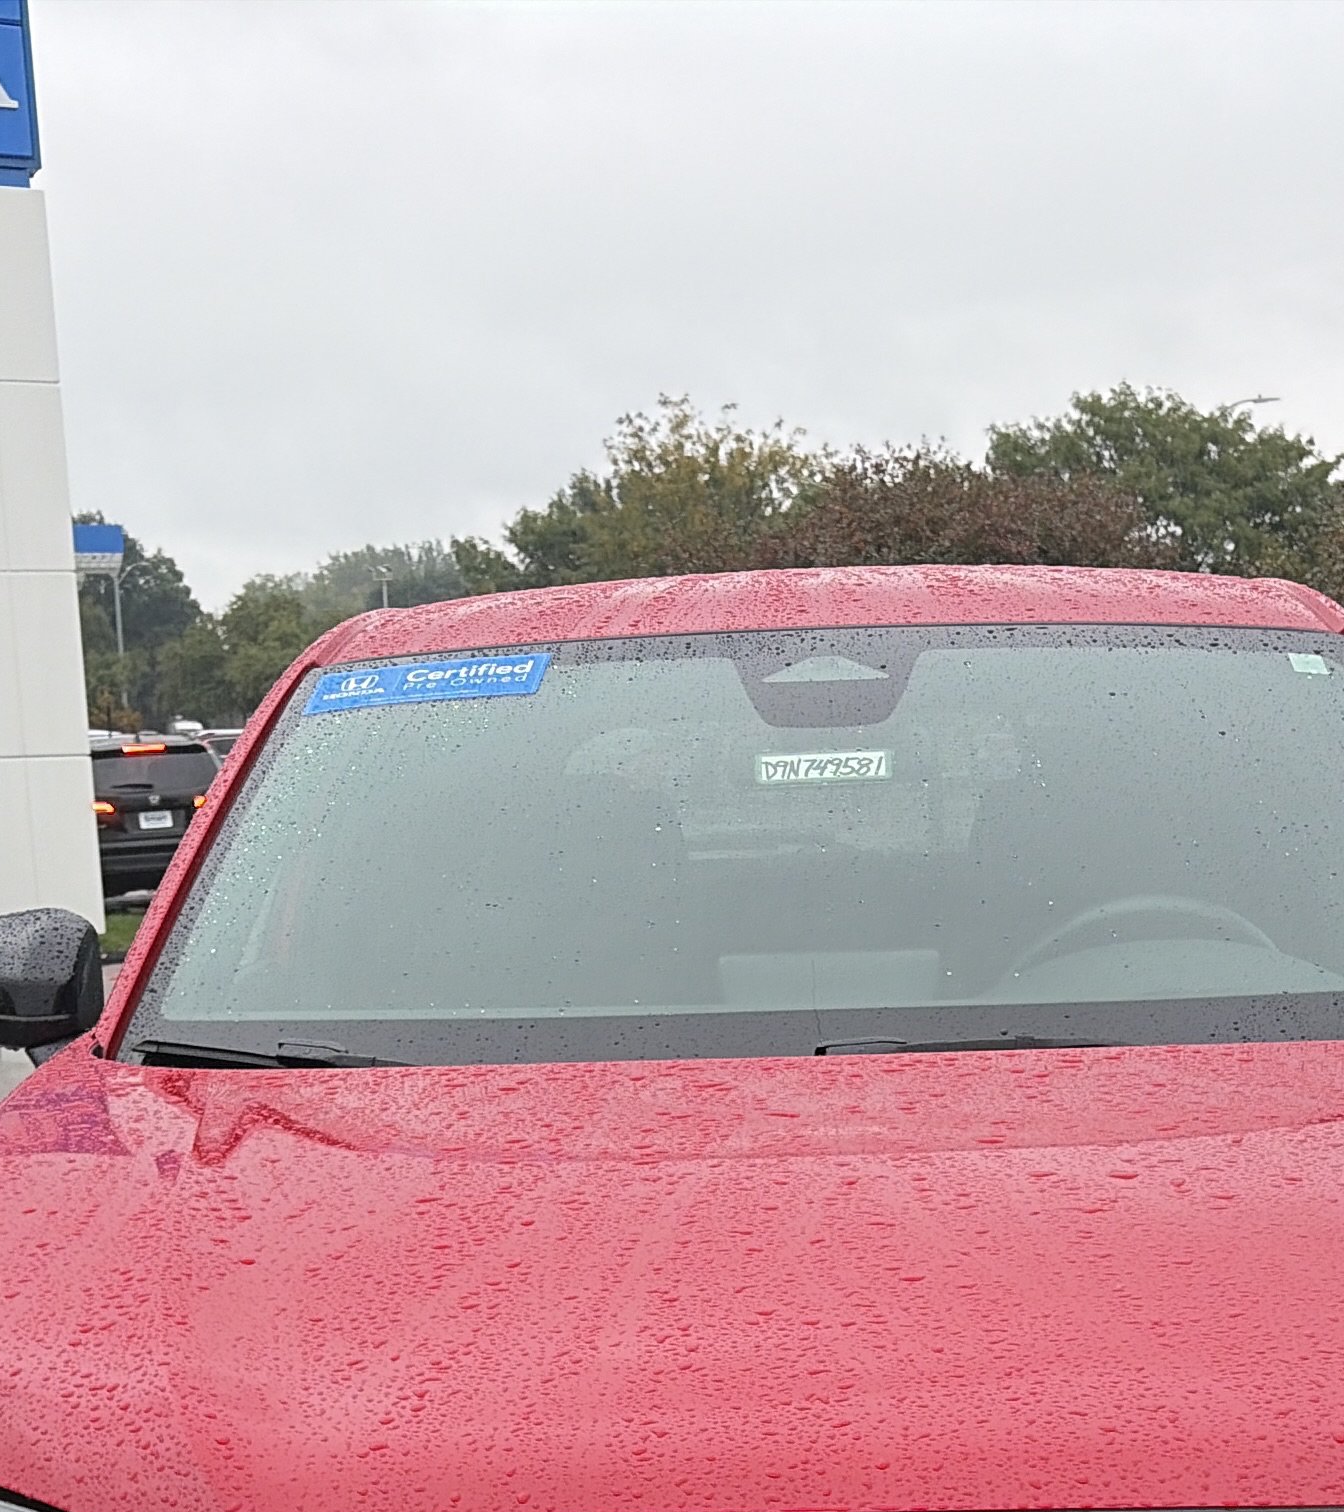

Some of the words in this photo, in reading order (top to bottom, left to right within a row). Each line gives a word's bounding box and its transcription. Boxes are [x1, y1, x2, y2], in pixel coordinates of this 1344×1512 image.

[407, 660, 534, 682] Certified
[450, 673, 528, 686] Owned
[322, 687, 385, 700] HONDA
